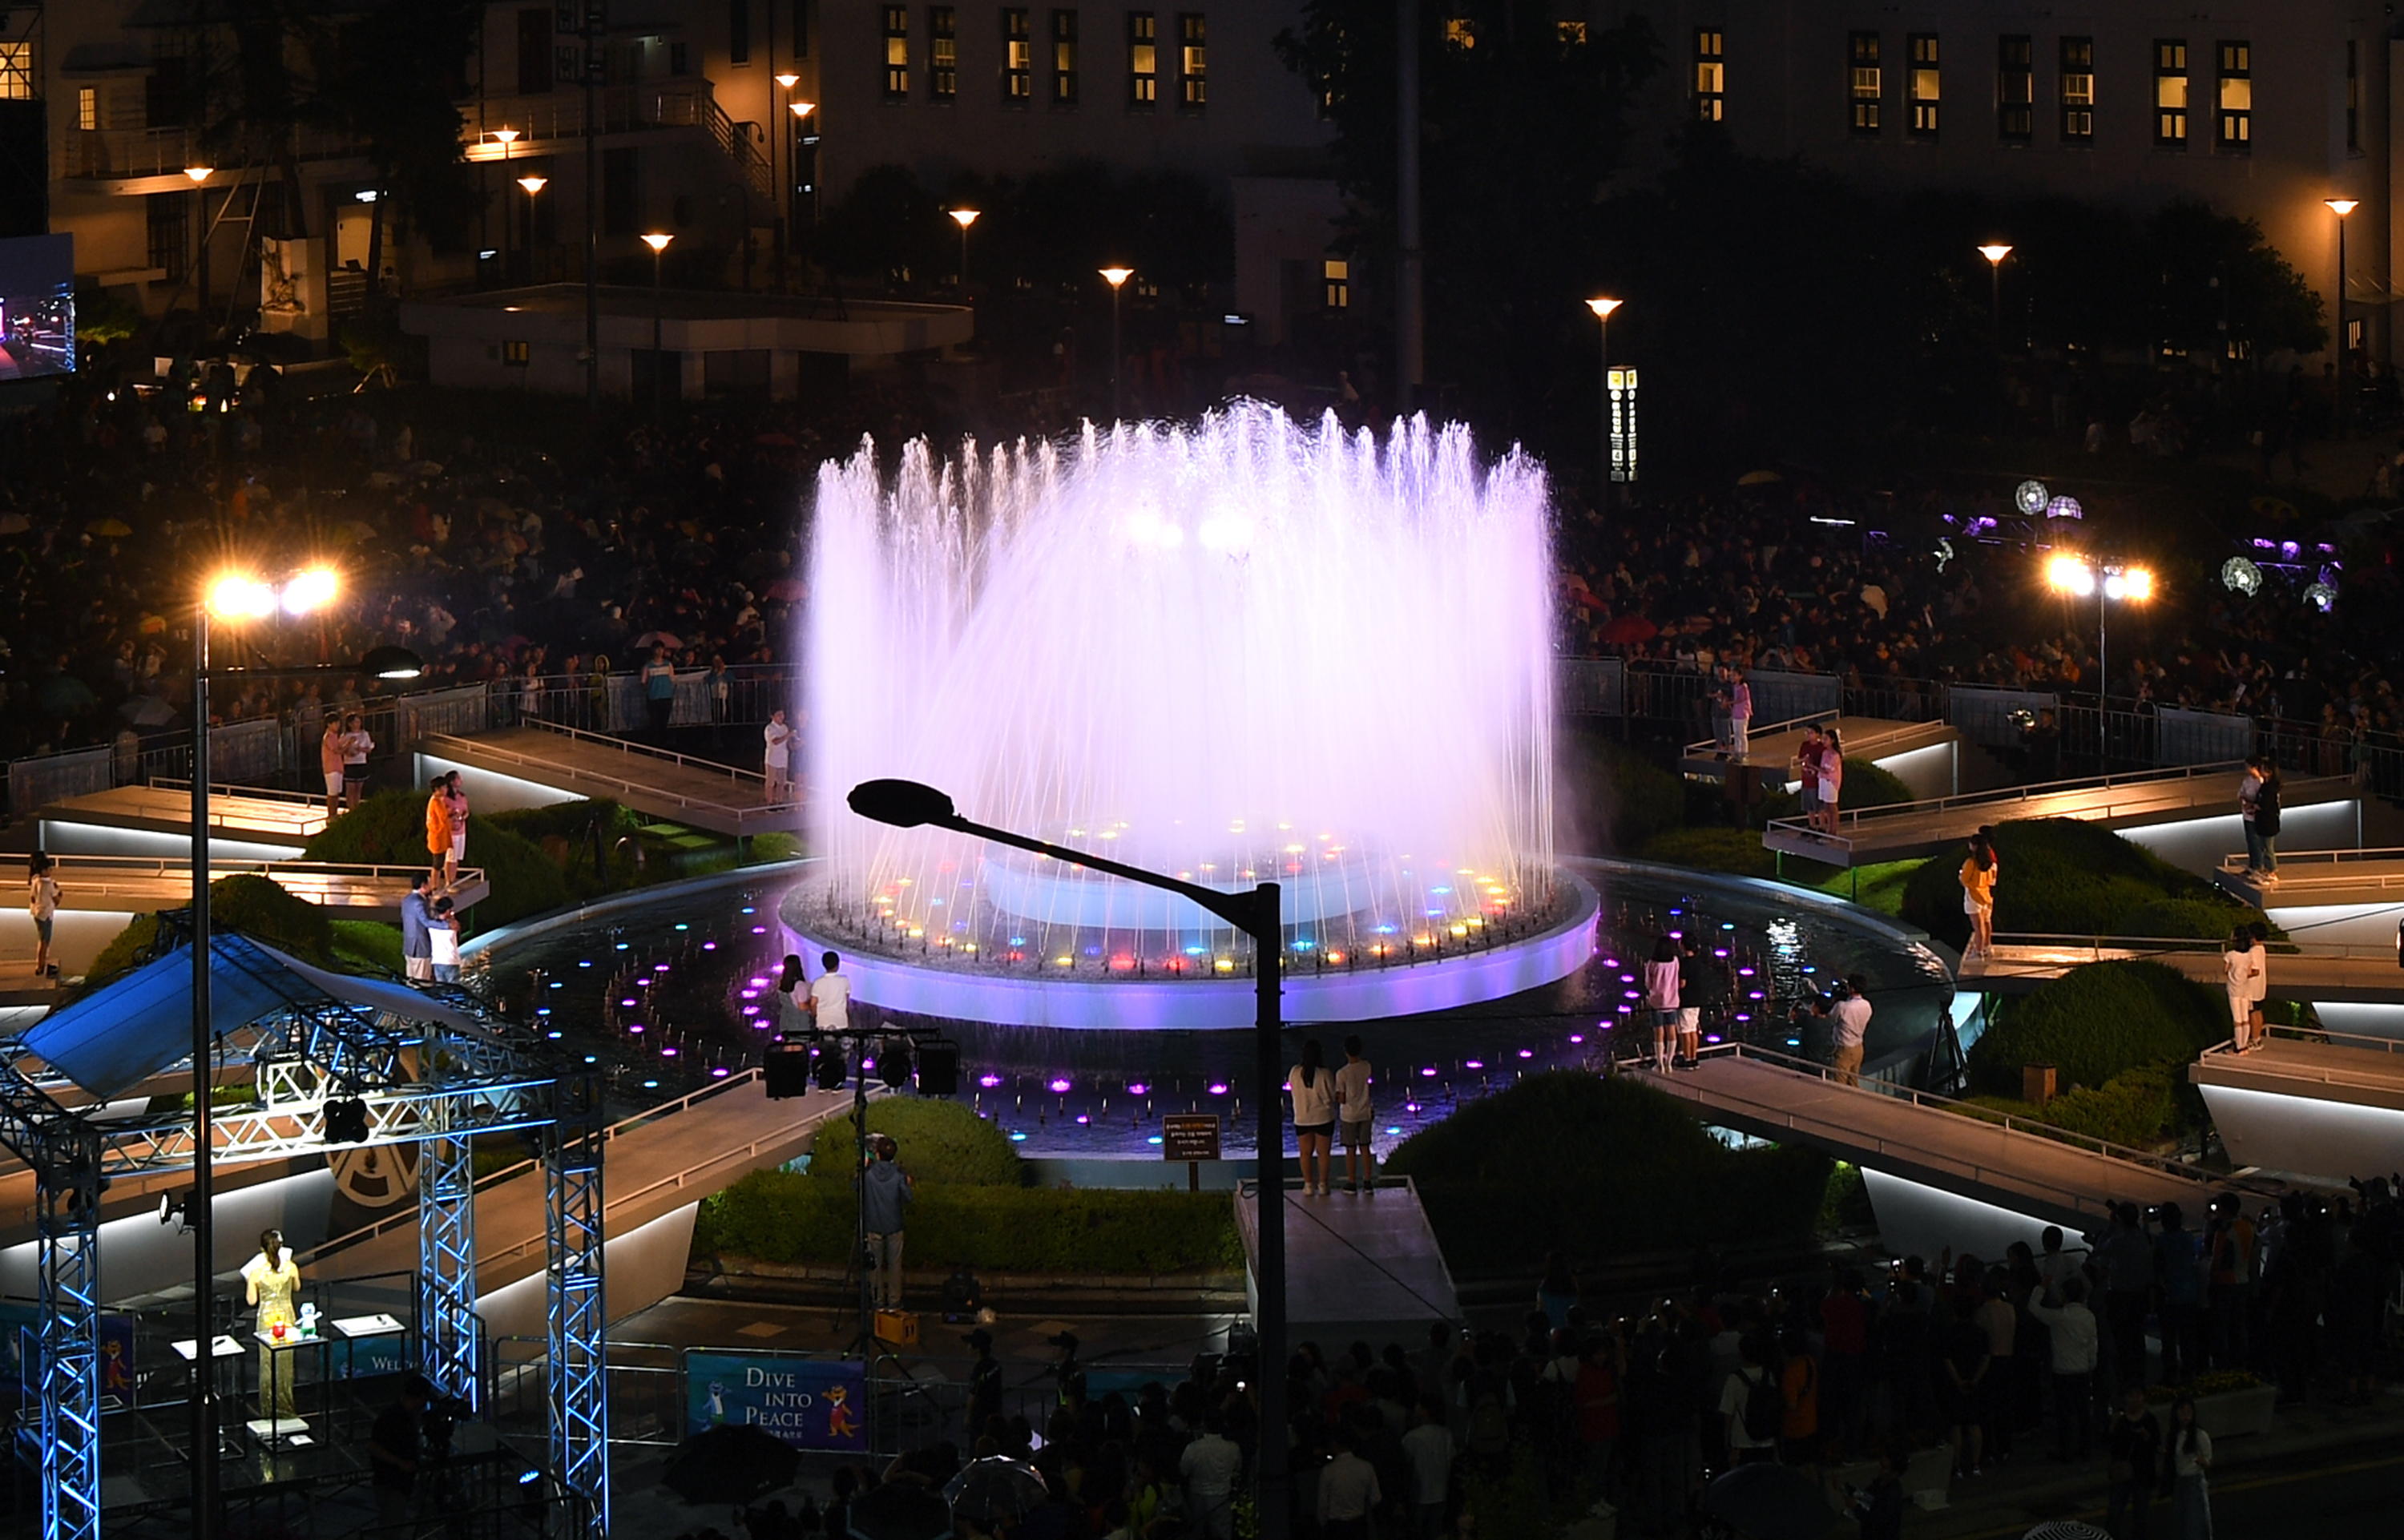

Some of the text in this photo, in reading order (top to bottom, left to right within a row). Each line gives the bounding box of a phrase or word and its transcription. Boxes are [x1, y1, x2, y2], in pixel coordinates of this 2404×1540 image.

[745, 1367, 795, 1388] DIVE
[765, 1393, 812, 1408] INTO
[745, 1406, 803, 1427] PEACE
